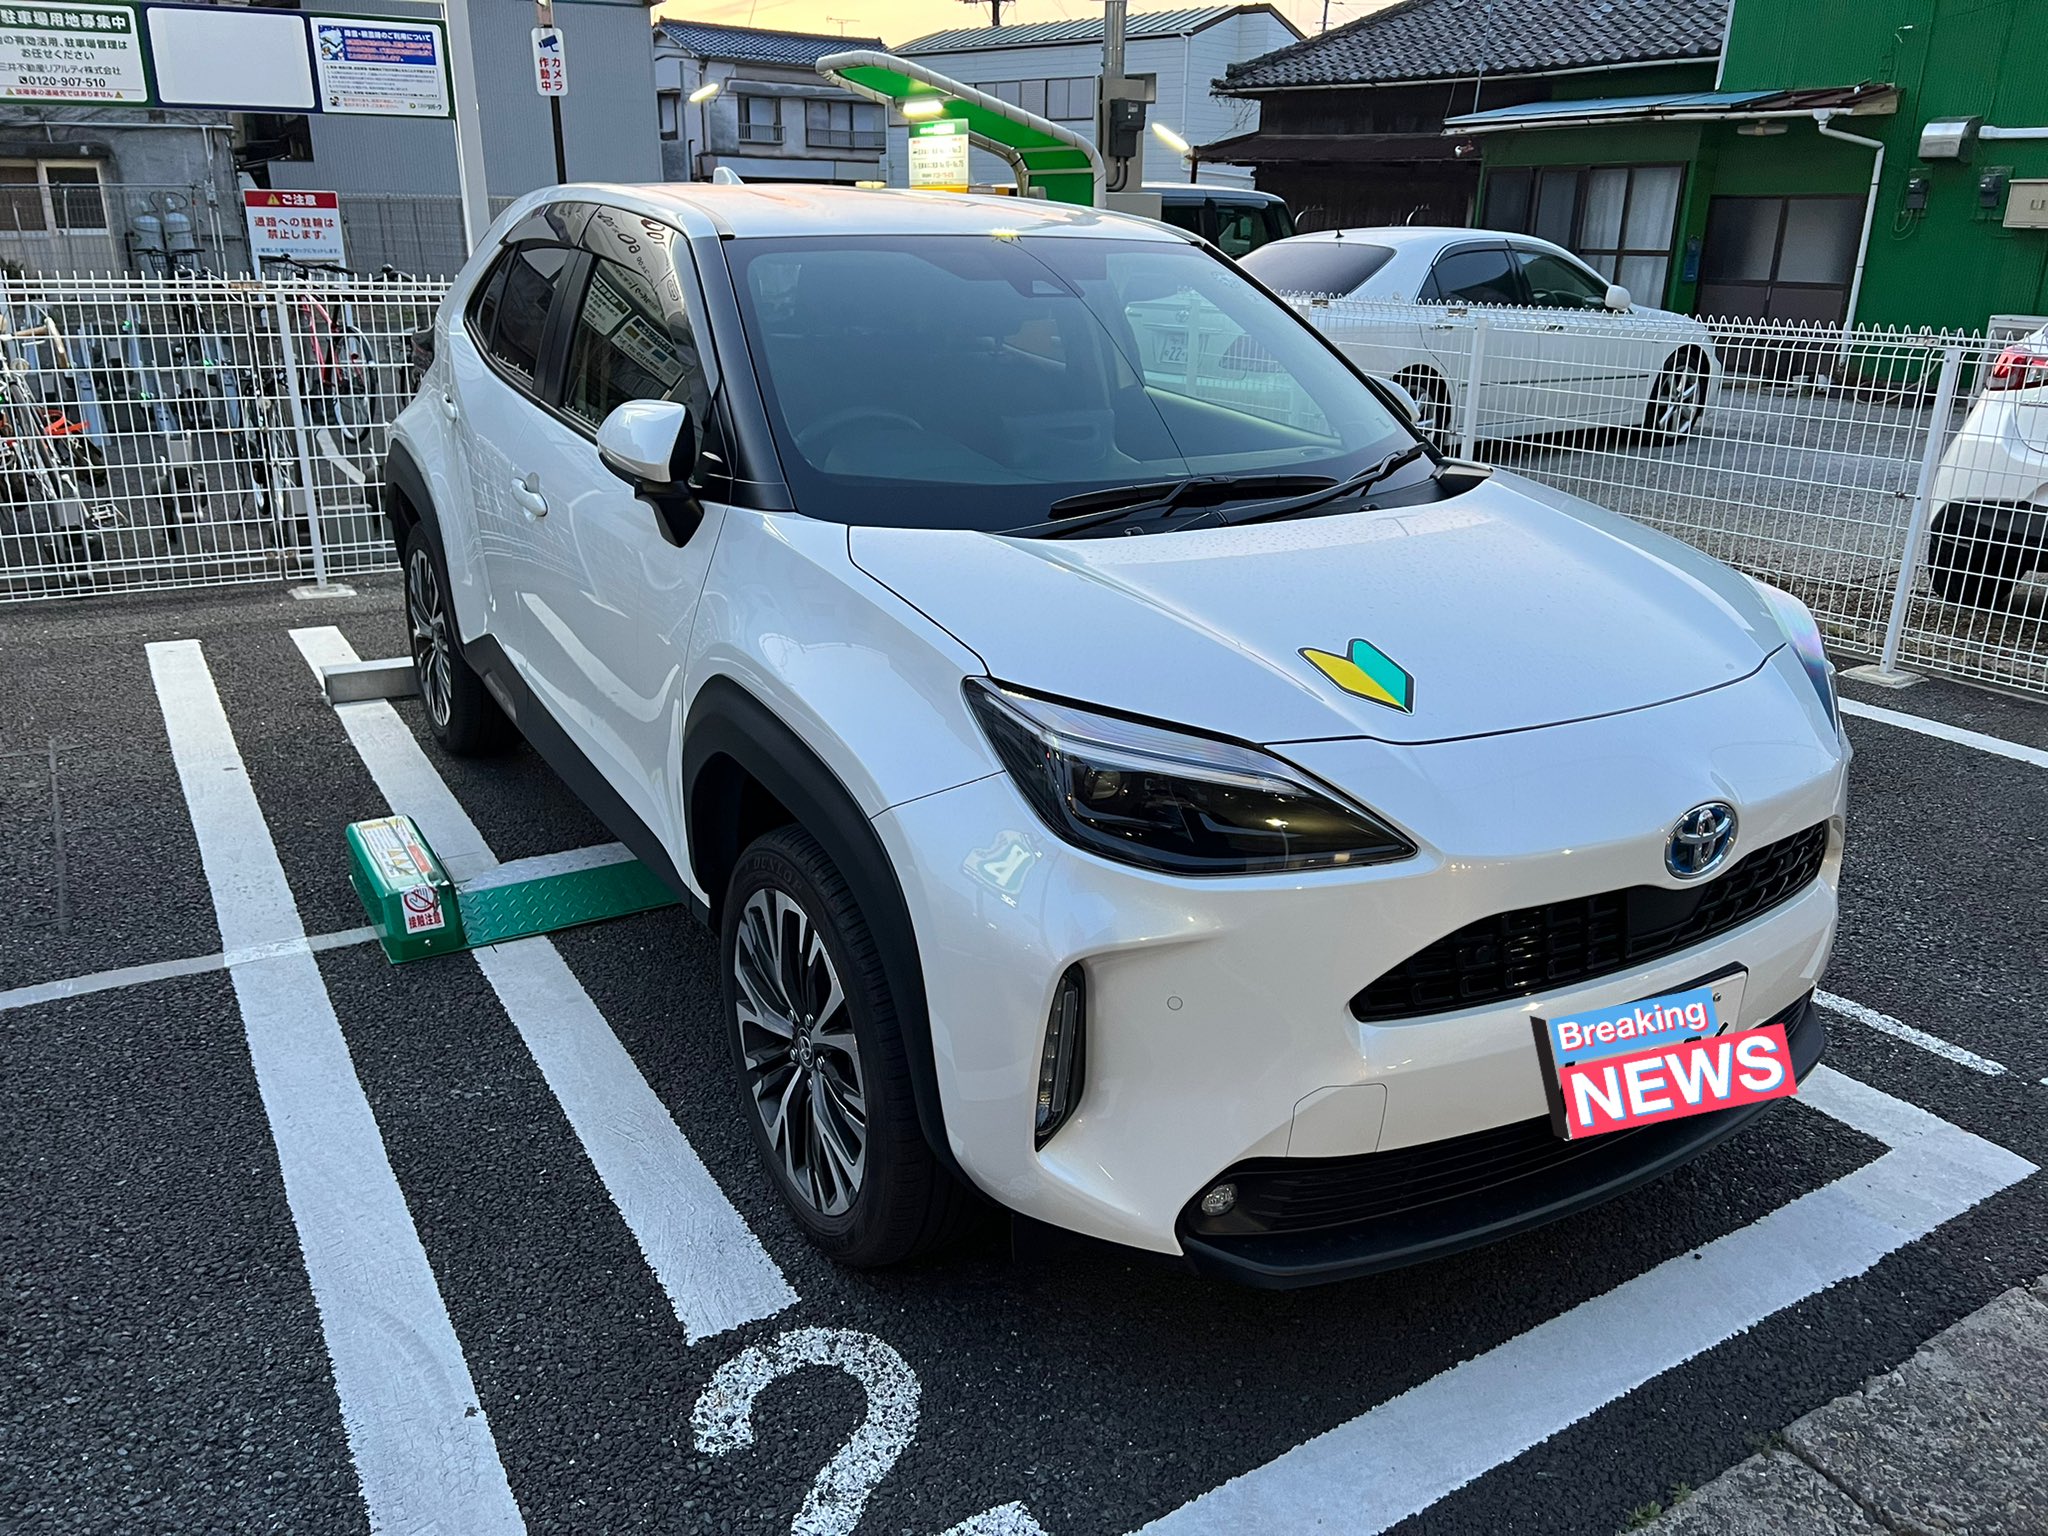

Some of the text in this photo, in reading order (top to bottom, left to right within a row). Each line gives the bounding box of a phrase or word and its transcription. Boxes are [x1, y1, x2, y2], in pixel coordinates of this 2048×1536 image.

[21, 48, 95, 60] お任せください
[551, 57, 563, 91] カメラ
[28, 75, 106, 88] 0120-907-510
[282, 193, 317, 206] ご注意
[254, 216, 334, 228] 通路への駐輪は
[268, 229, 327, 240] 禁止します。
[408, 912, 442, 929] 接触注意
